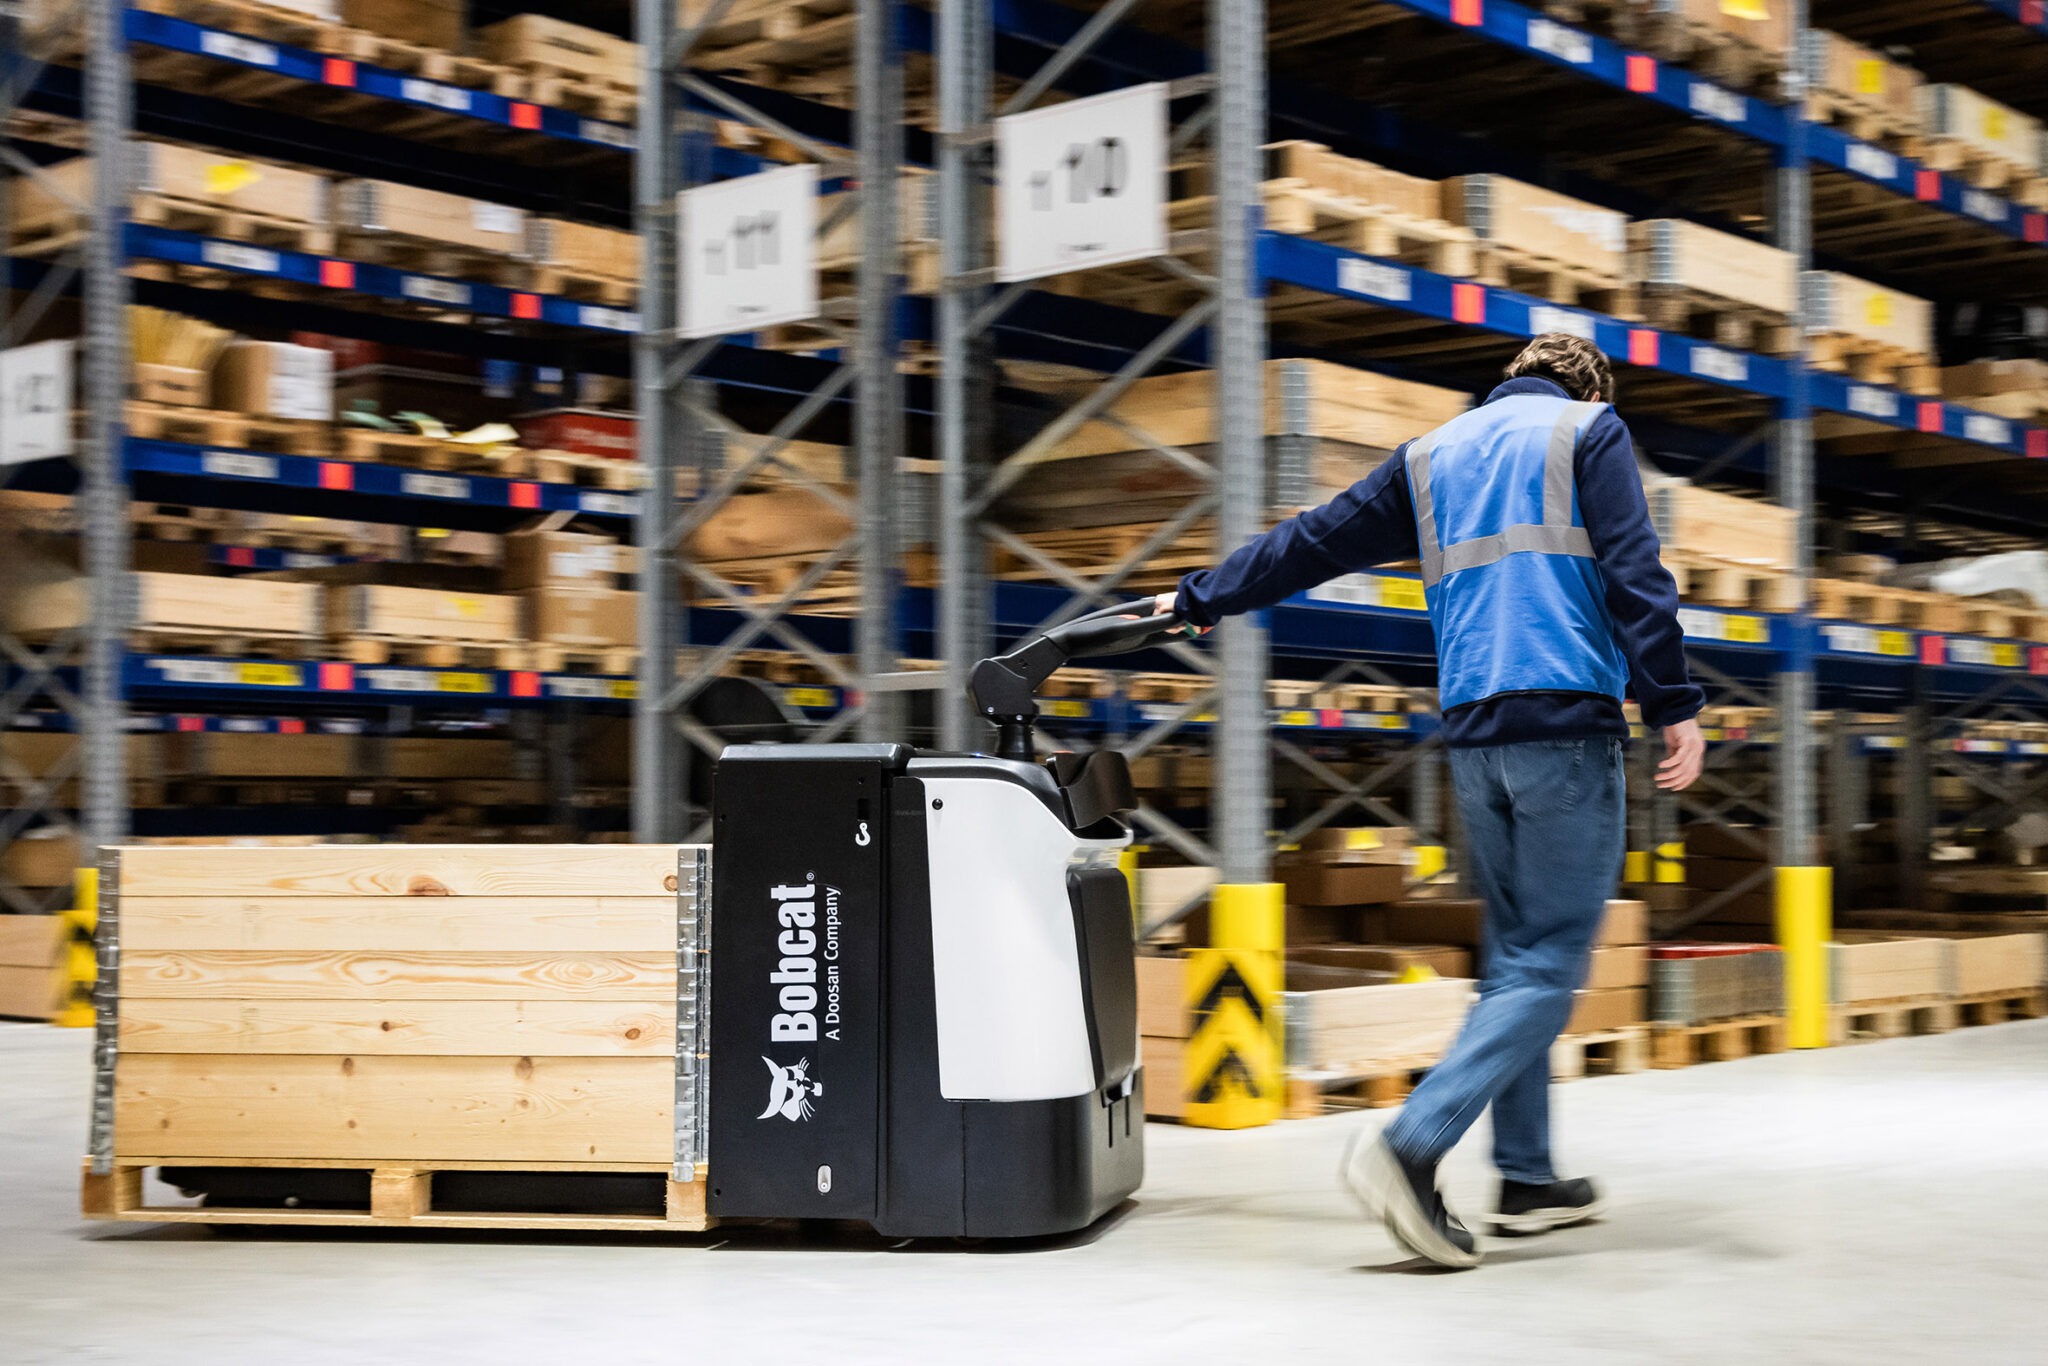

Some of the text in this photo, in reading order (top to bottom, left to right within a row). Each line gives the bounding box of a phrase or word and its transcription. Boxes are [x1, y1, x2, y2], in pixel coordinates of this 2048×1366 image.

[823, 887, 842, 1041] A Doosan Company
